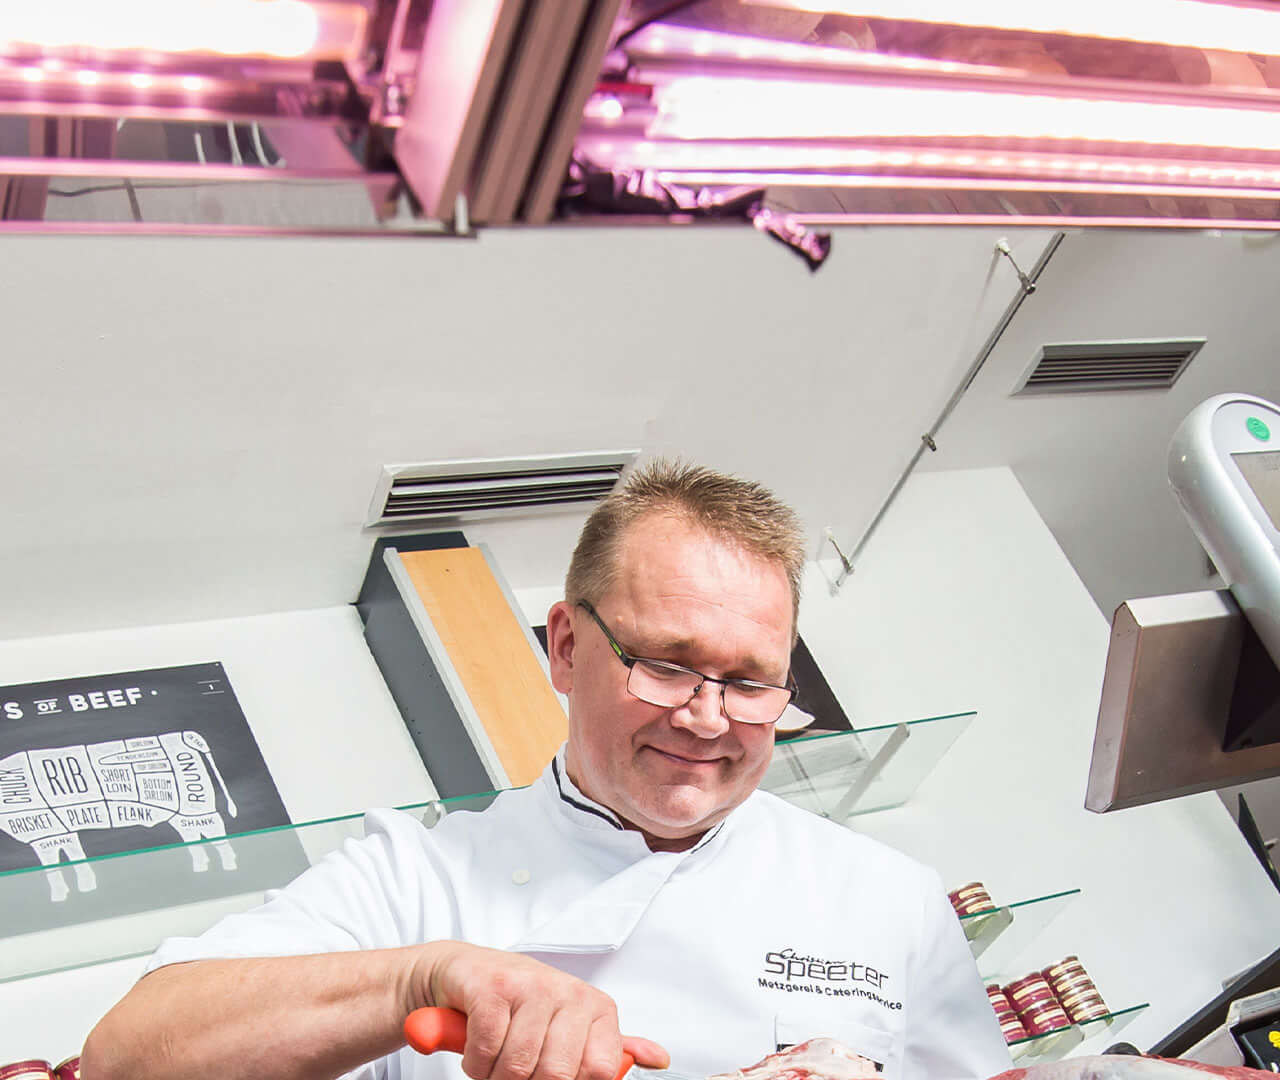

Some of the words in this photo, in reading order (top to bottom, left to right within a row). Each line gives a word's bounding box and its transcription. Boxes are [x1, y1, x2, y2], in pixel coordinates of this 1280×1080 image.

[36, 701, 58, 712] OF
[68, 687, 143, 712] BEEF
[41, 756, 89, 796] RIB
[100, 767, 131, 783] SHORT
[176, 751, 206, 804] ROUND
[105, 783, 133, 794] LOIN
[142, 778, 173, 790] BOTTOM
[143, 790, 174, 802] SIRLOIN
[66, 806, 103, 827] PLATE
[117, 805, 154, 822] FLANK
[8, 812, 54, 835] BRISKET
[180, 817, 216, 828] SHANK
[40, 836, 74, 850] SHANK
[765, 952, 888, 989] Speeter
[758, 978, 813, 992] Metzgerei
